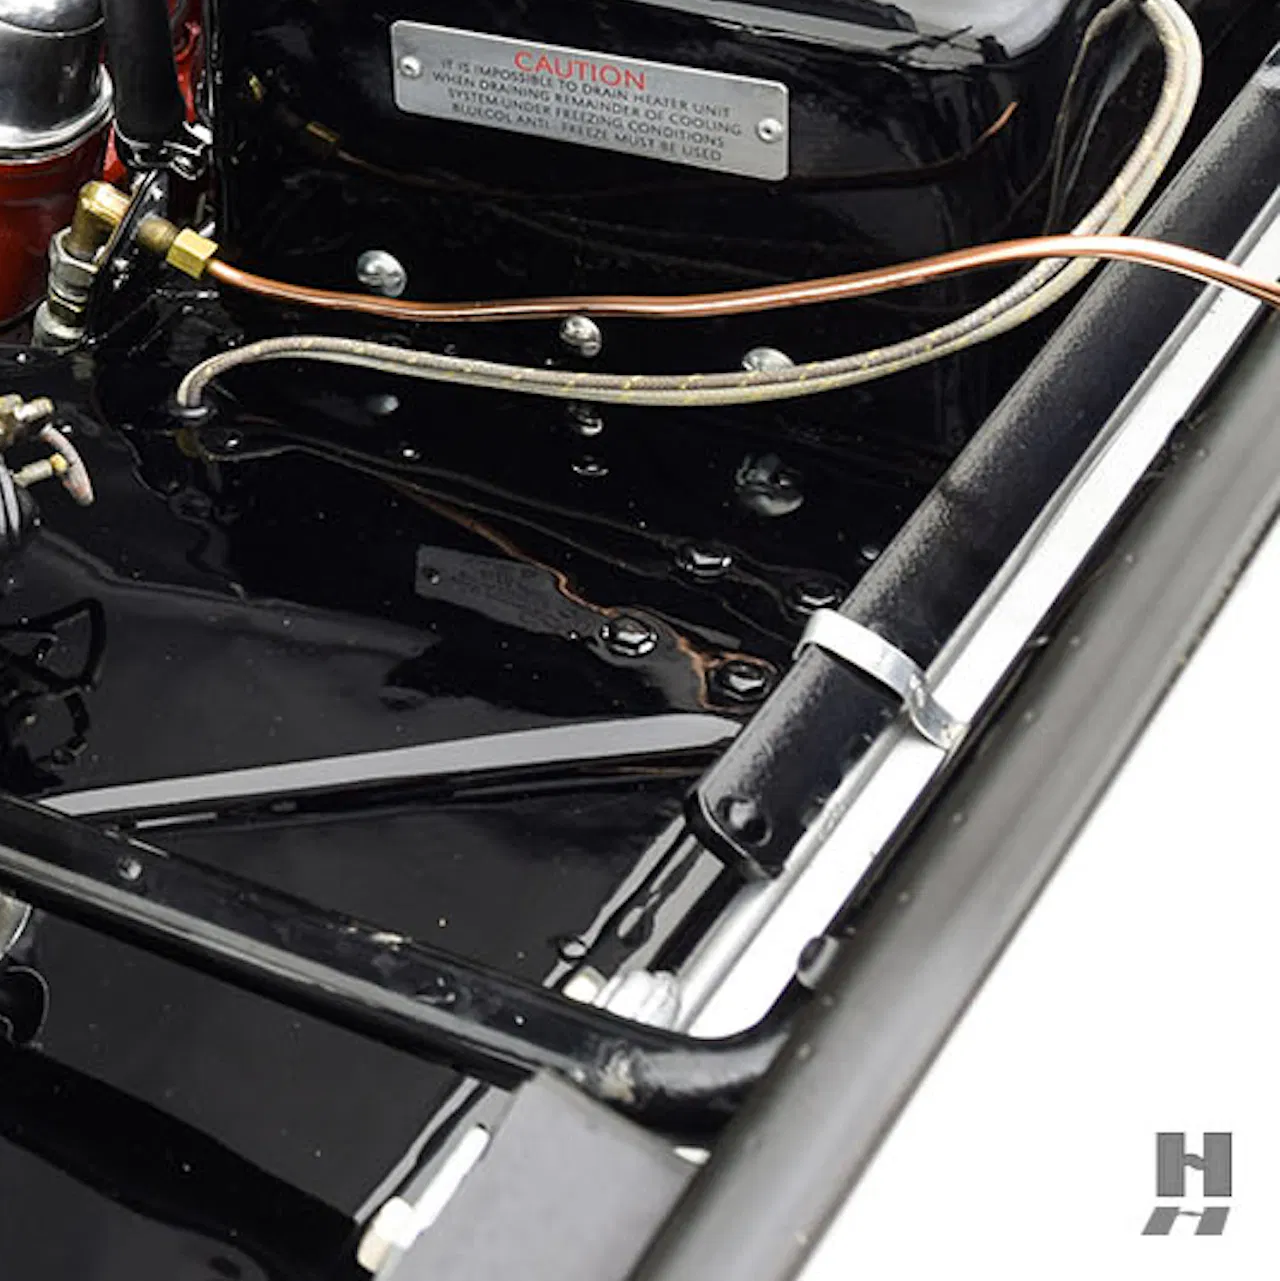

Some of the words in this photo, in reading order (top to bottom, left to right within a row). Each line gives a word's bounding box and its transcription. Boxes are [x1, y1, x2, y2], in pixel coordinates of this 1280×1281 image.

[473, 63, 553, 89] IMPOSSIBLE
[559, 79, 578, 93] TO
[582, 83, 628, 101] DRAIN
[634, 94, 689, 111] HEATER
[692, 103, 731, 118] UNIT
[514, 50, 646, 90] CAUTION
[432, 71, 475, 87] WHEN
[479, 79, 552, 102] DRAINING
[555, 92, 640, 116] REMAINDER
[645, 108, 664, 121] OF
[669, 113, 742, 137] COOLING
[448, 87, 497, 104] SYSTEM
[501, 97, 552, 115] UNDER
[555, 106, 623, 130] FREEZING
[628, 120, 725, 149] CONDITIONS
[614, 133, 655, 149] MUST
[660, 141, 676, 154] BE
[682, 145, 722, 162] USED
